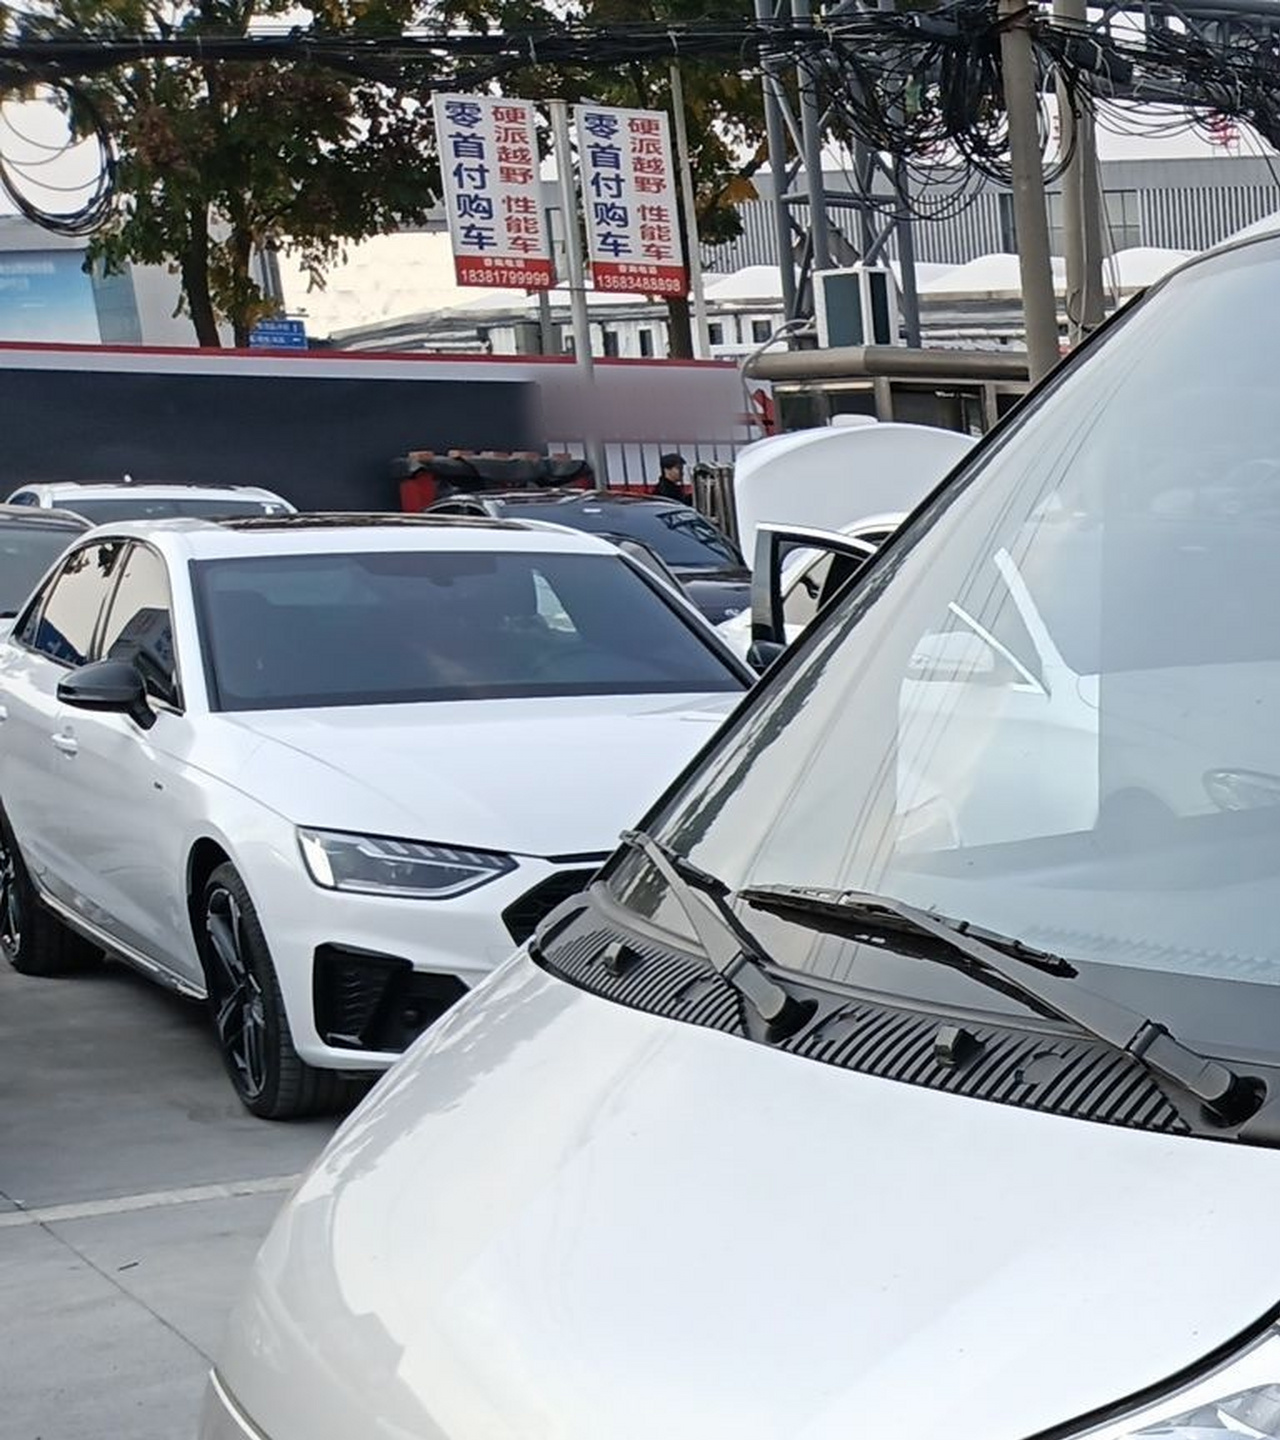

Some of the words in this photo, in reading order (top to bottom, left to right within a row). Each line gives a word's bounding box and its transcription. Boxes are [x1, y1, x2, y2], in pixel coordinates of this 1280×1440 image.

[444, 101, 498, 250] 零首付购车
[491, 105, 533, 185] 硬派越野
[627, 117, 667, 194] 硬派越野
[584, 112, 632, 257] 零首付购车
[502, 195, 541, 254] 性能车
[637, 204, 673, 261] 性能车
